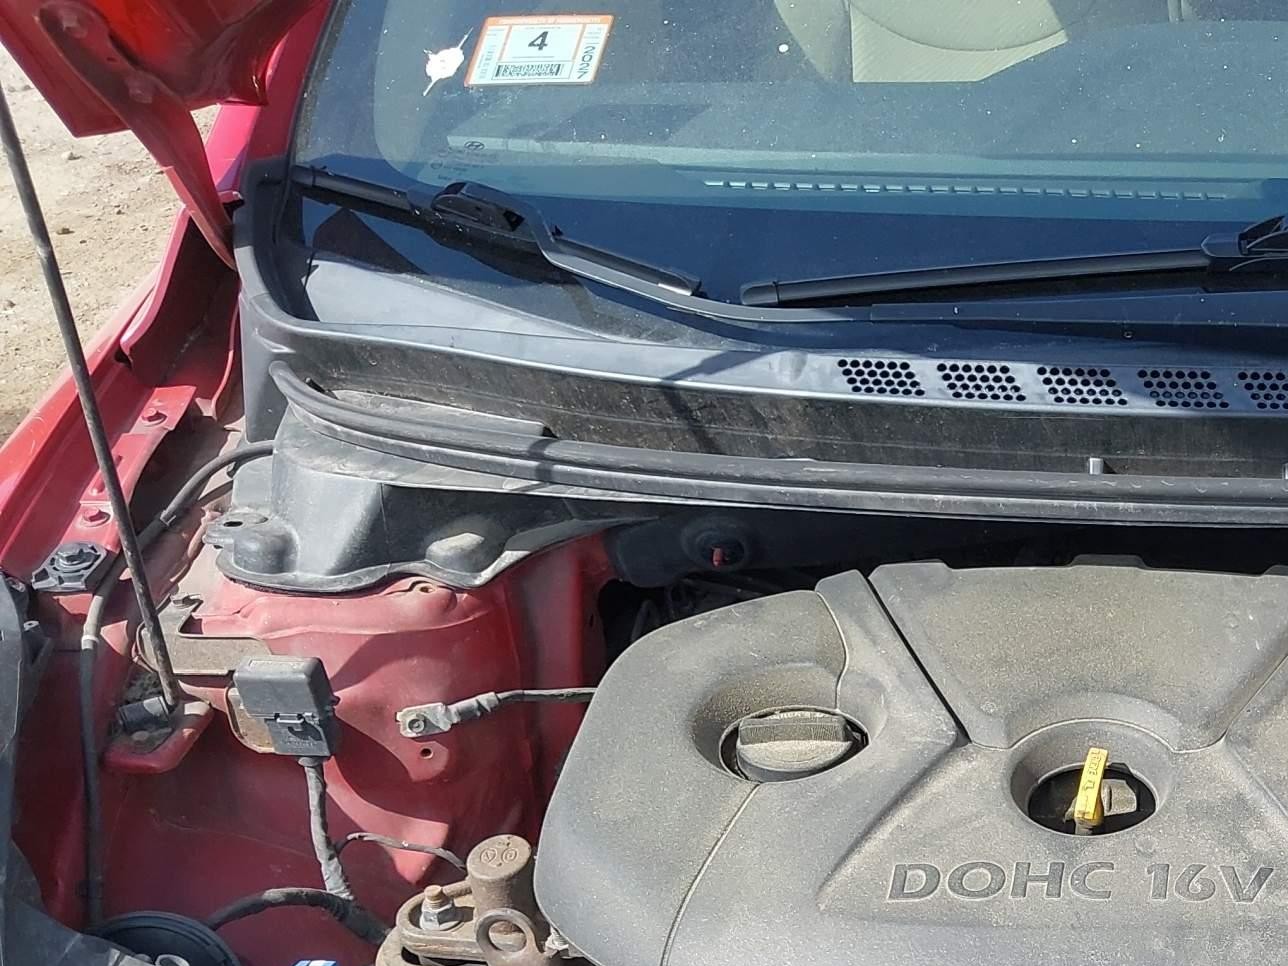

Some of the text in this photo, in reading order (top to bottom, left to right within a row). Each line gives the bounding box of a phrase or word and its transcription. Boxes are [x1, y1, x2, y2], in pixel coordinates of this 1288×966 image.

[528, 31, 550, 51] 4
[576, 45, 596, 80] 2027
[887, 861, 1274, 903] DOHC 16V
